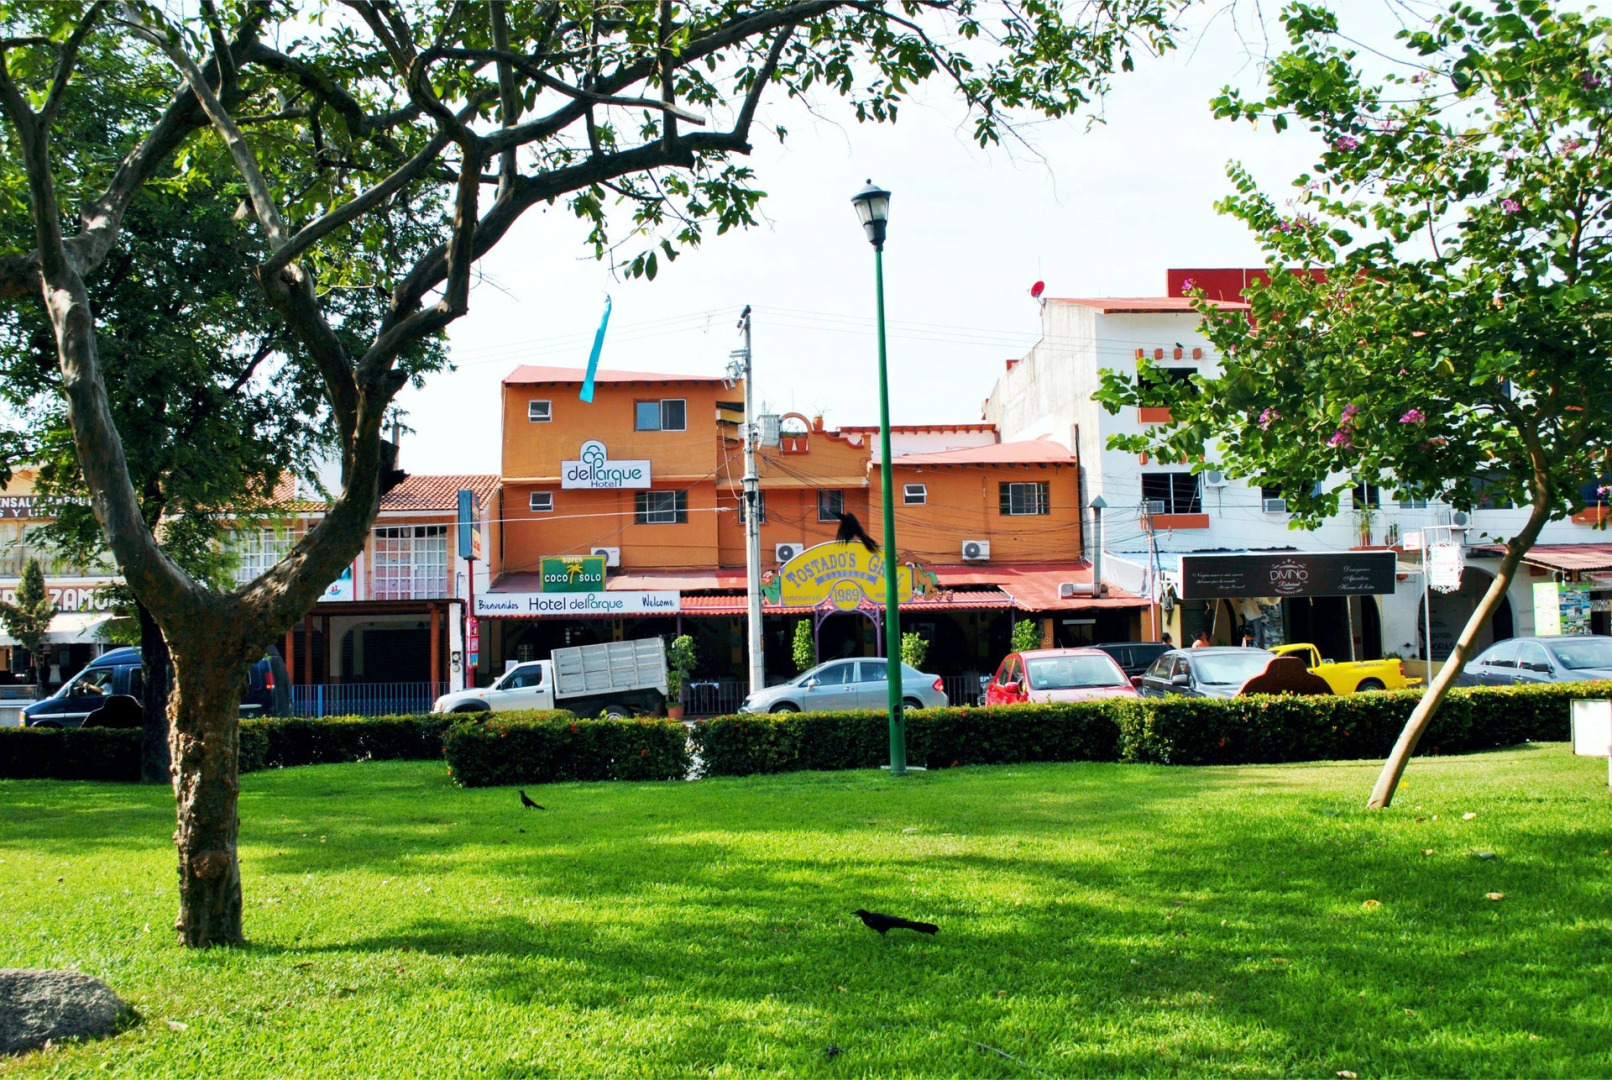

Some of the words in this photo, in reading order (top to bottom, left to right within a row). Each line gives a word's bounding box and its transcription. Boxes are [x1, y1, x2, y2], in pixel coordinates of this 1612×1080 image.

[591, 480, 617, 488] Hotel
[562, 556, 583, 564] SUPER
[785, 551, 856, 588] TOSTADO'S
[544, 574, 569, 582] COCO
[579, 573, 601, 582] SOLO
[833, 588, 860, 602] 1989
[478, 600, 519, 610] Bienvenidos
[529, 597, 566, 611] Hotel
[642, 594, 675, 607] Welcome
